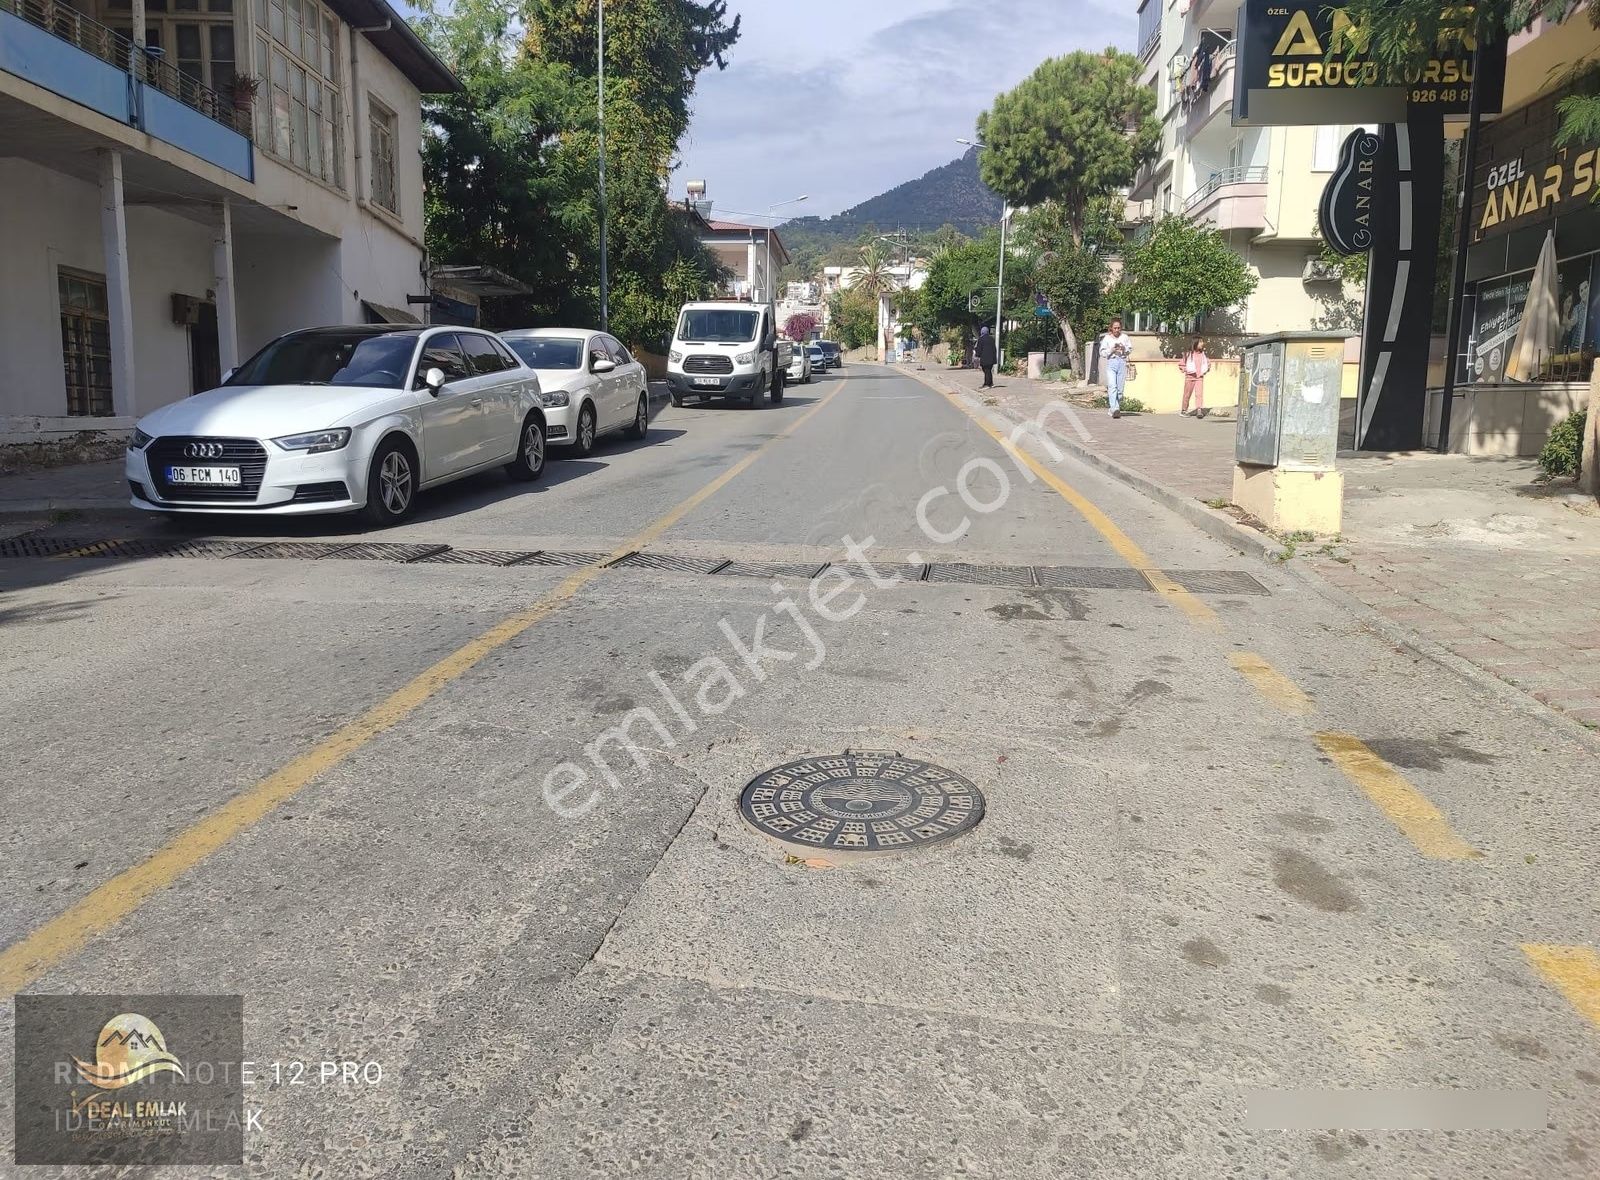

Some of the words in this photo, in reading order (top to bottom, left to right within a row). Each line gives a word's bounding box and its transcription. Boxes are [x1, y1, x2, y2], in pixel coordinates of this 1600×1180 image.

[1412, 90, 1437, 102] 926
[1440, 89, 1457, 101] 48
[1487, 158, 1525, 191] ÖZEL
[1480, 164, 1563, 230] ANAR
[172, 467, 186, 481] 06
[191, 468, 212, 482] FCM
[219, 469, 239, 482] 140
